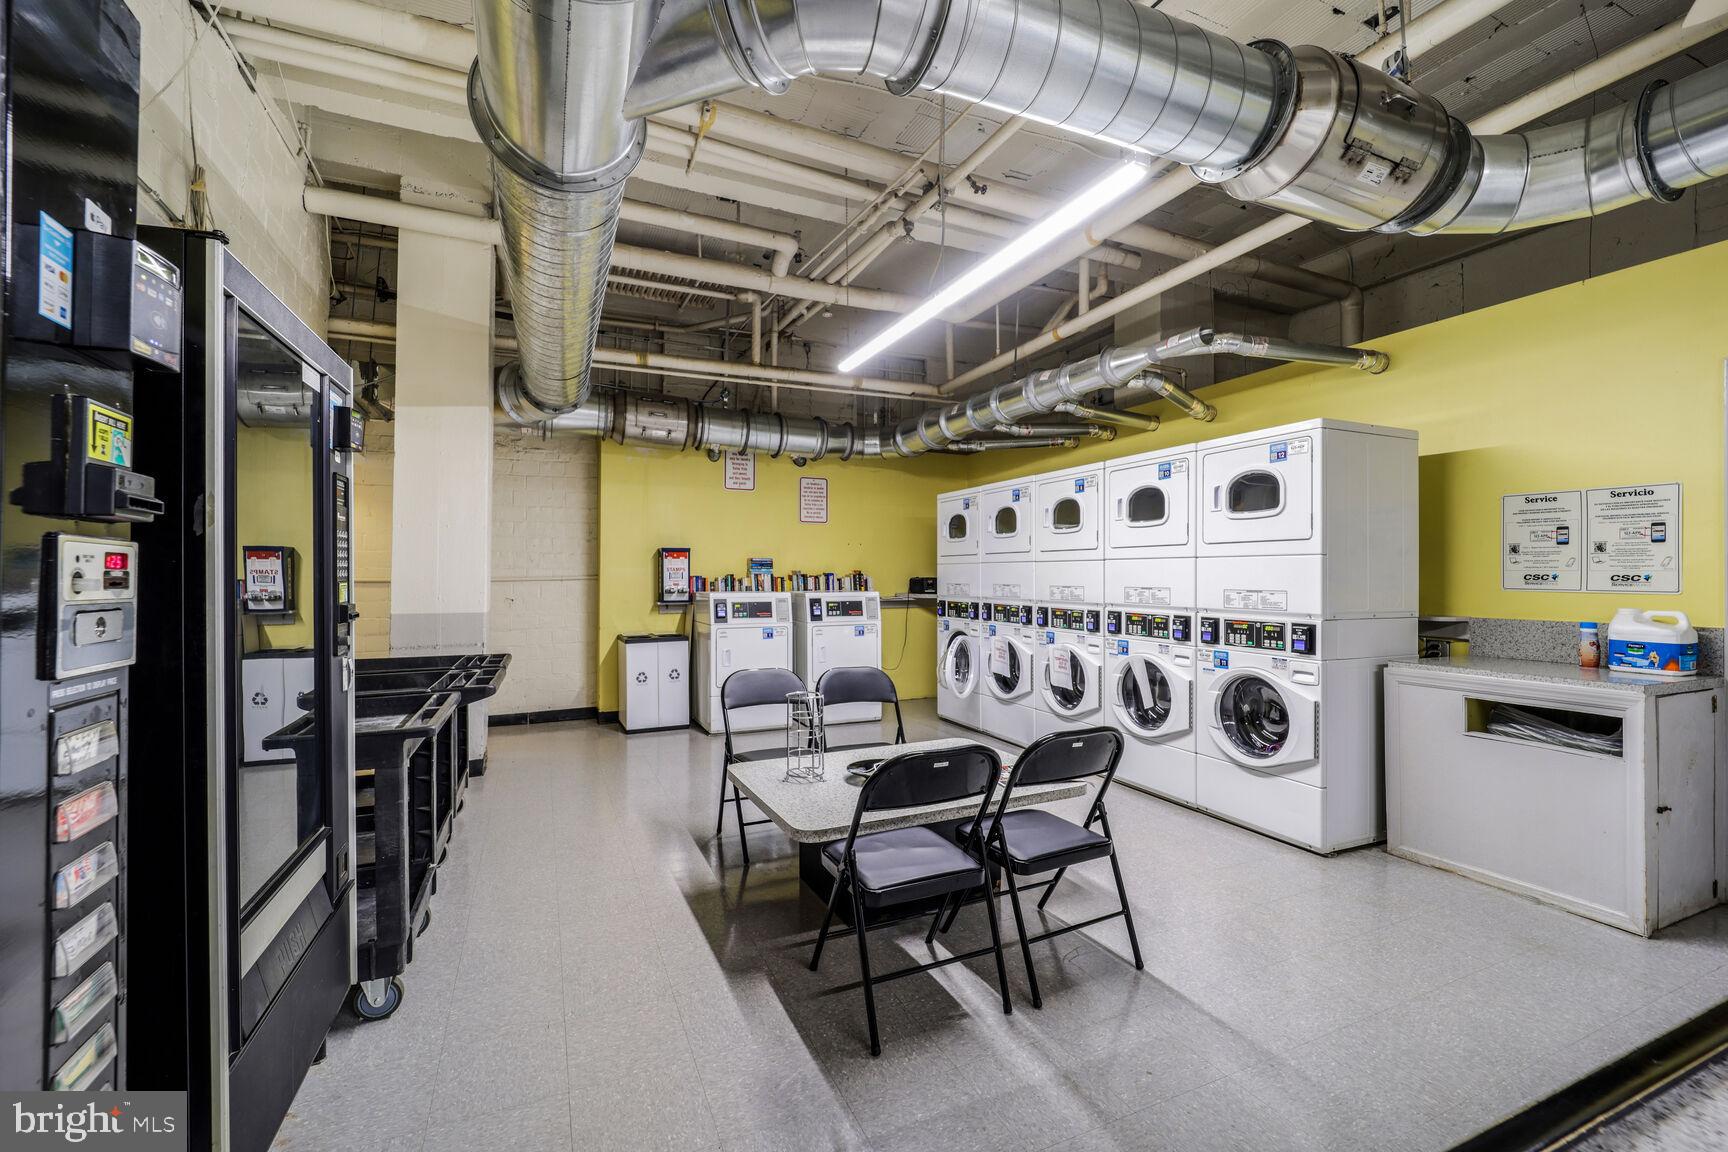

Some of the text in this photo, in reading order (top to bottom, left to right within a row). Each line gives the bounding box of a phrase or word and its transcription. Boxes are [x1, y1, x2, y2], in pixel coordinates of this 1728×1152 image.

[1610, 488, 1655, 499] Servicio
[1524, 495, 1558, 504] Service
[1523, 573, 1551, 581] CSC
[1610, 574, 1642, 582] CSC
[276, 920, 308, 976] PUSH
